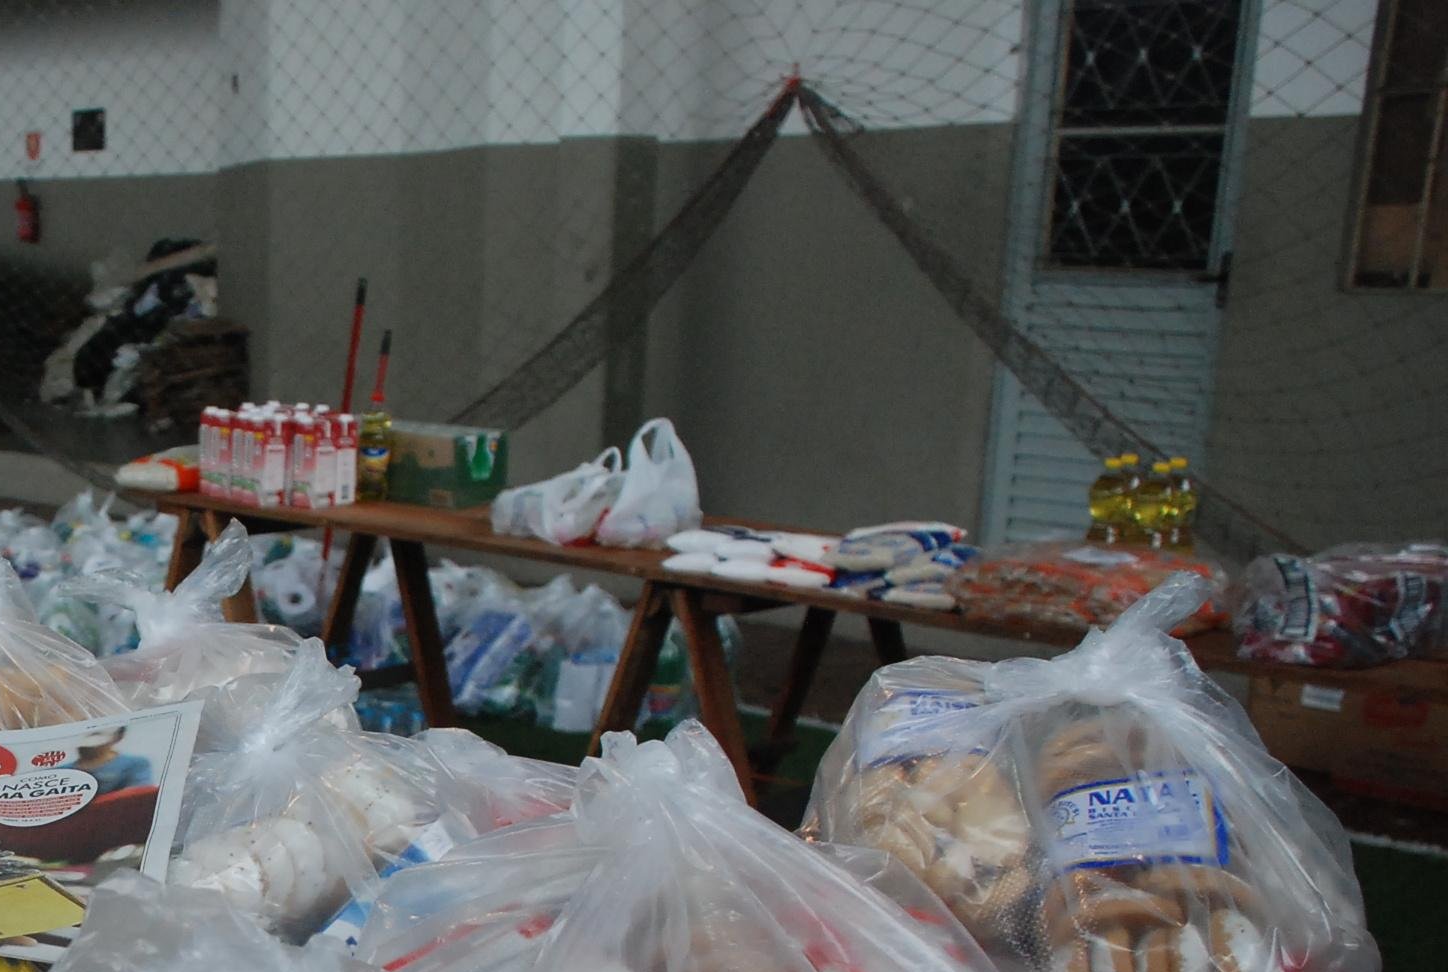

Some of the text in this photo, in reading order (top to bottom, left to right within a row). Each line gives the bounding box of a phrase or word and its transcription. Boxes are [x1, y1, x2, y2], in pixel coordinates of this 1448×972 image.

[2, 777, 71, 791] NASCE
[20, 774, 58, 783] COMO
[29, 782, 93, 799] GAITA
